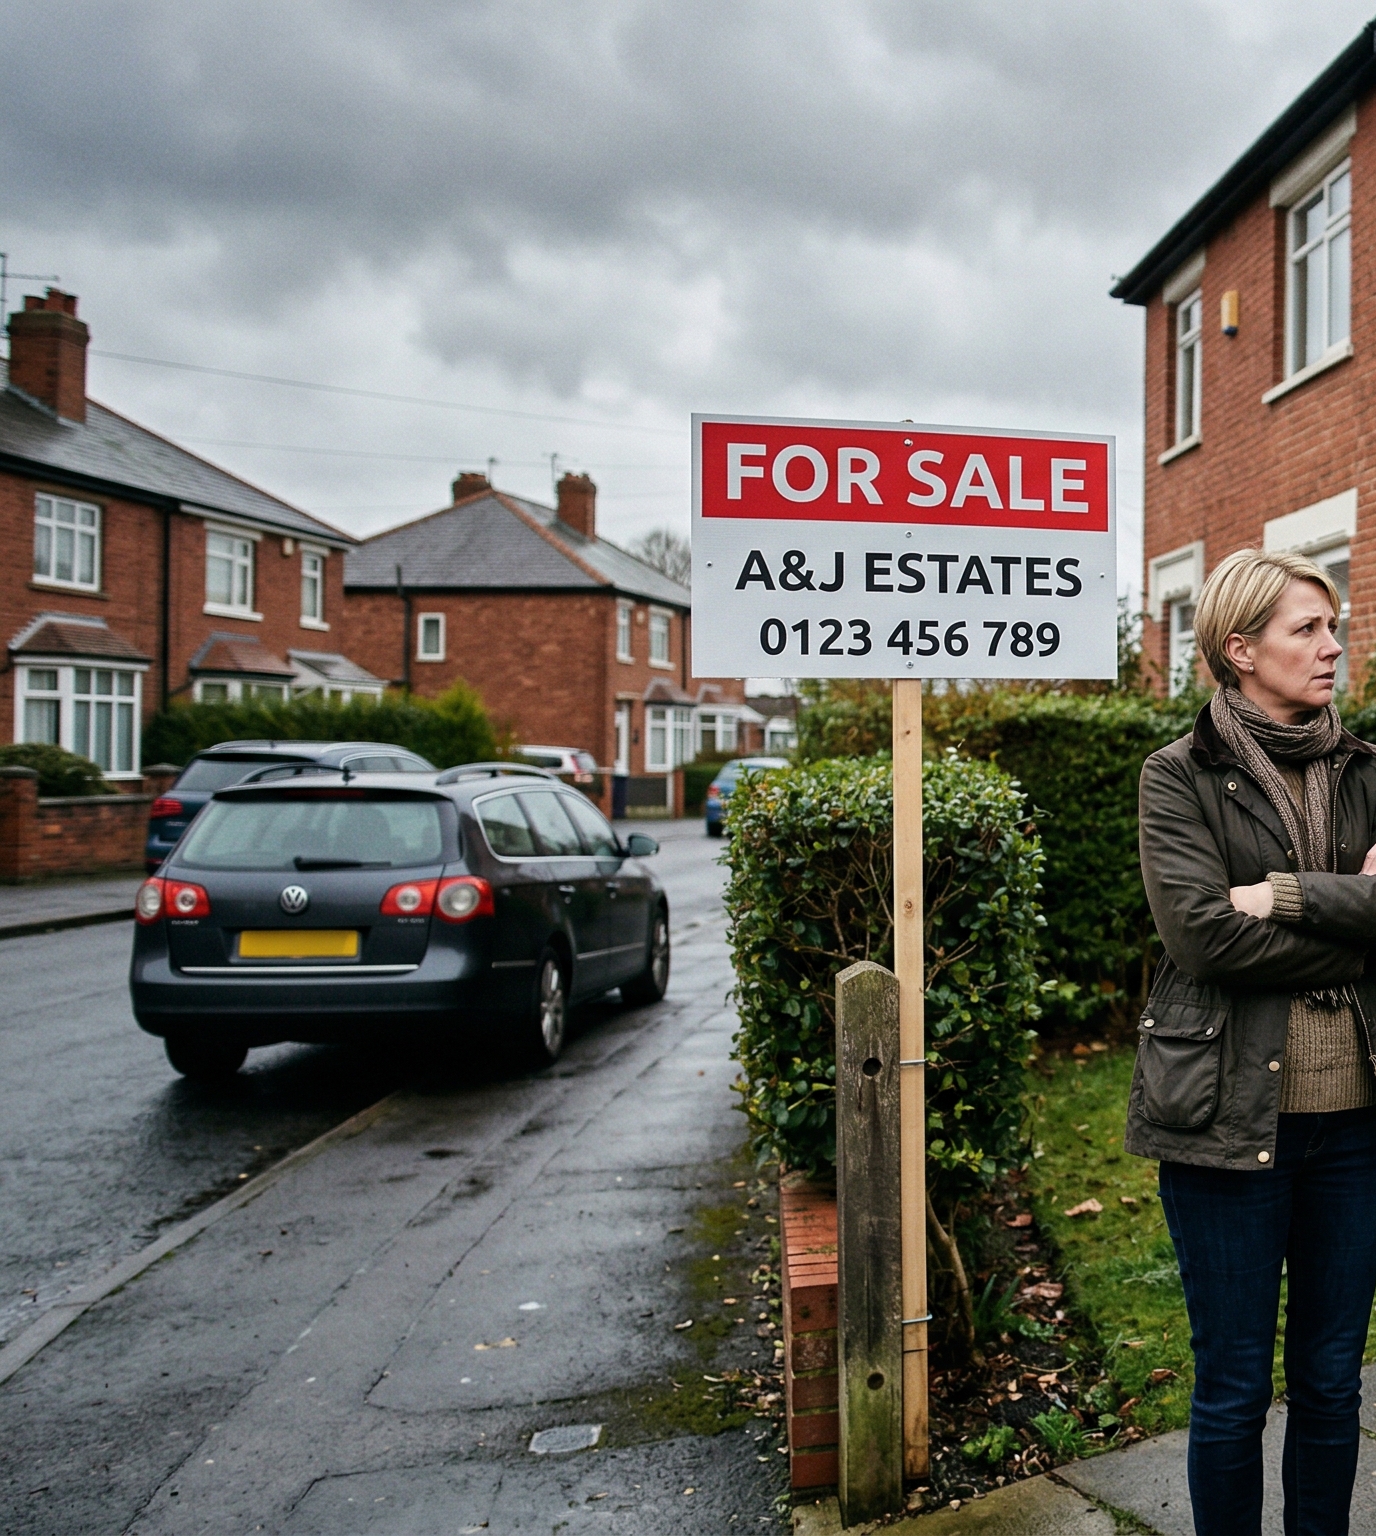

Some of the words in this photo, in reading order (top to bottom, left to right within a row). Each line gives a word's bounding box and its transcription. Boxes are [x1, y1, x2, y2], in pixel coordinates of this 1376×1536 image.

[726, 442, 884, 505] FOR
[906, 449, 1089, 514] SALE
[735, 550, 845, 592] A&J
[865, 552, 1082, 597] ESTATES
[760, 618, 872, 656] 0123
[887, 620, 969, 657] 456
[982, 621, 1061, 658] 789
